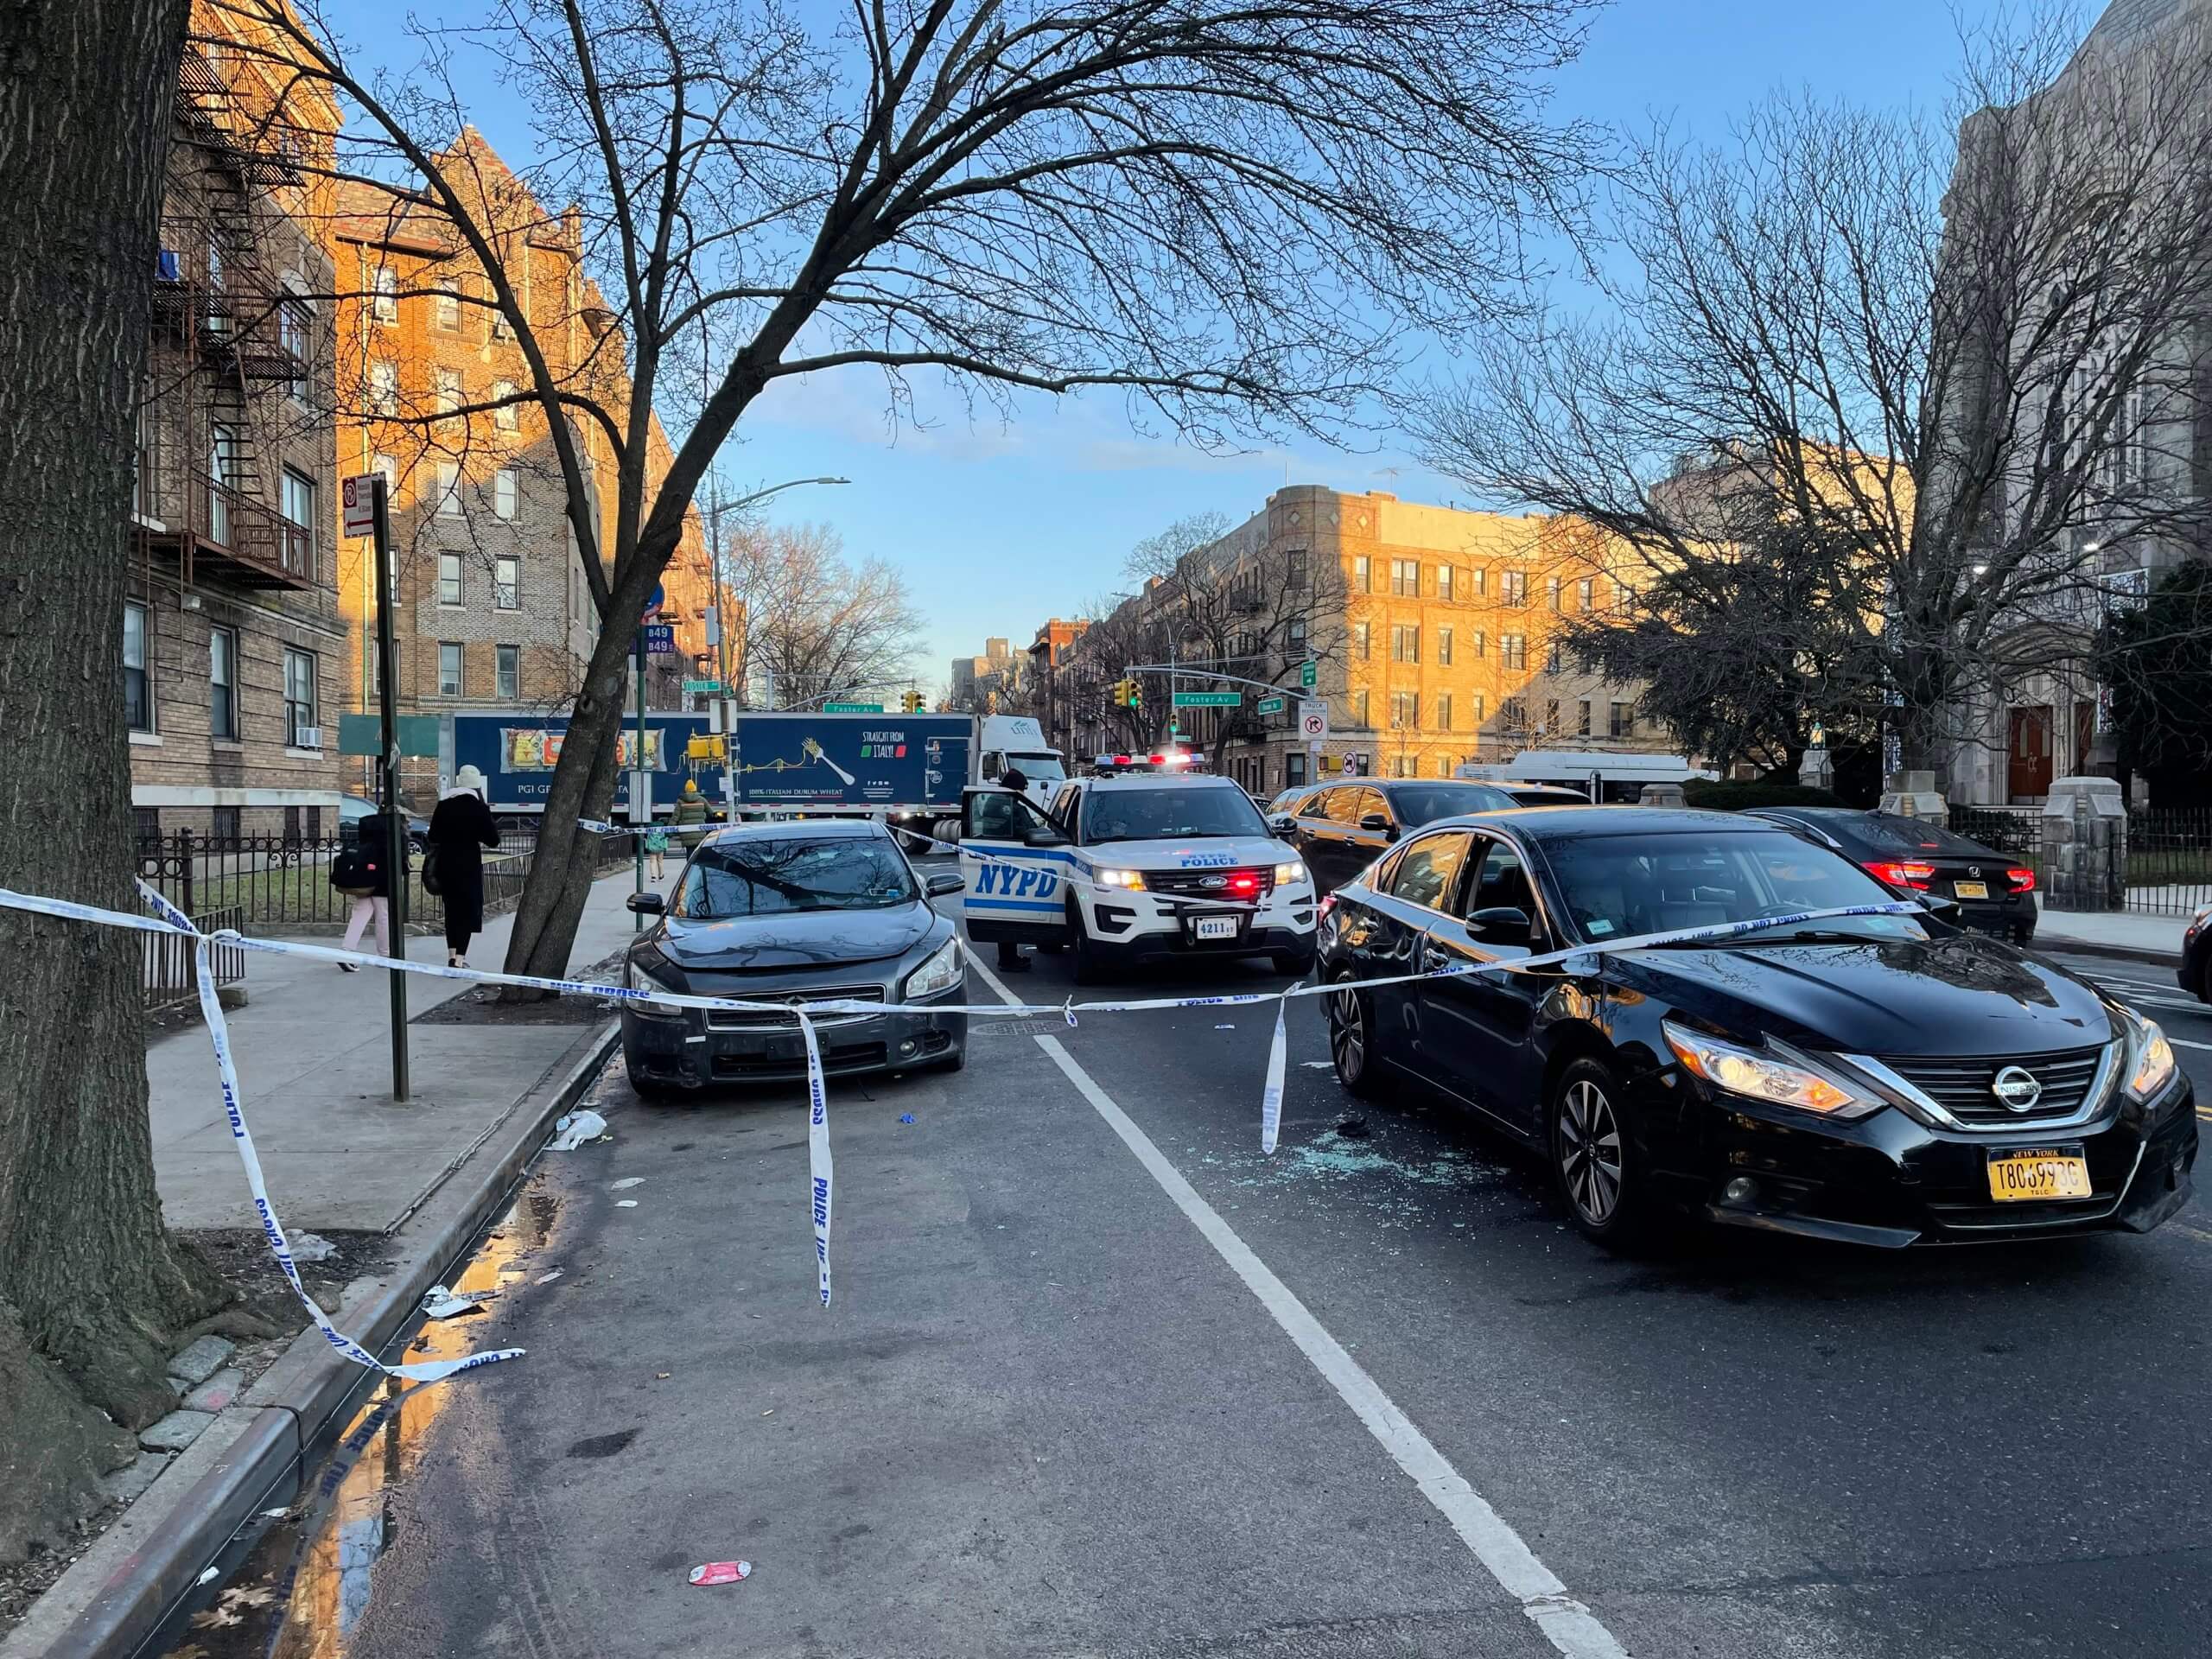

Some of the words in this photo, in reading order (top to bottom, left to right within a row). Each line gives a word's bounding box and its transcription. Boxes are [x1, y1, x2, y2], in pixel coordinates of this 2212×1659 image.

[649, 628, 668, 637] B49
[649, 642, 668, 651] B49
[862, 731, 889, 742] STRAIGHT
[889, 731, 905, 742] FROM
[873, 745, 894, 758] ITALY!
[518, 785, 535, 793] PGI
[1181, 857, 1239, 868] POLICE
[975, 864, 1058, 898] NYPD
[1200, 923, 1224, 934] 4211
[1999, 1084, 2039, 1094] NISSAN
[2012, 1149, 2034, 1159] NEW
[2035, 1148, 2060, 1158] YORK
[813, 1176, 829, 1229] POLICE
